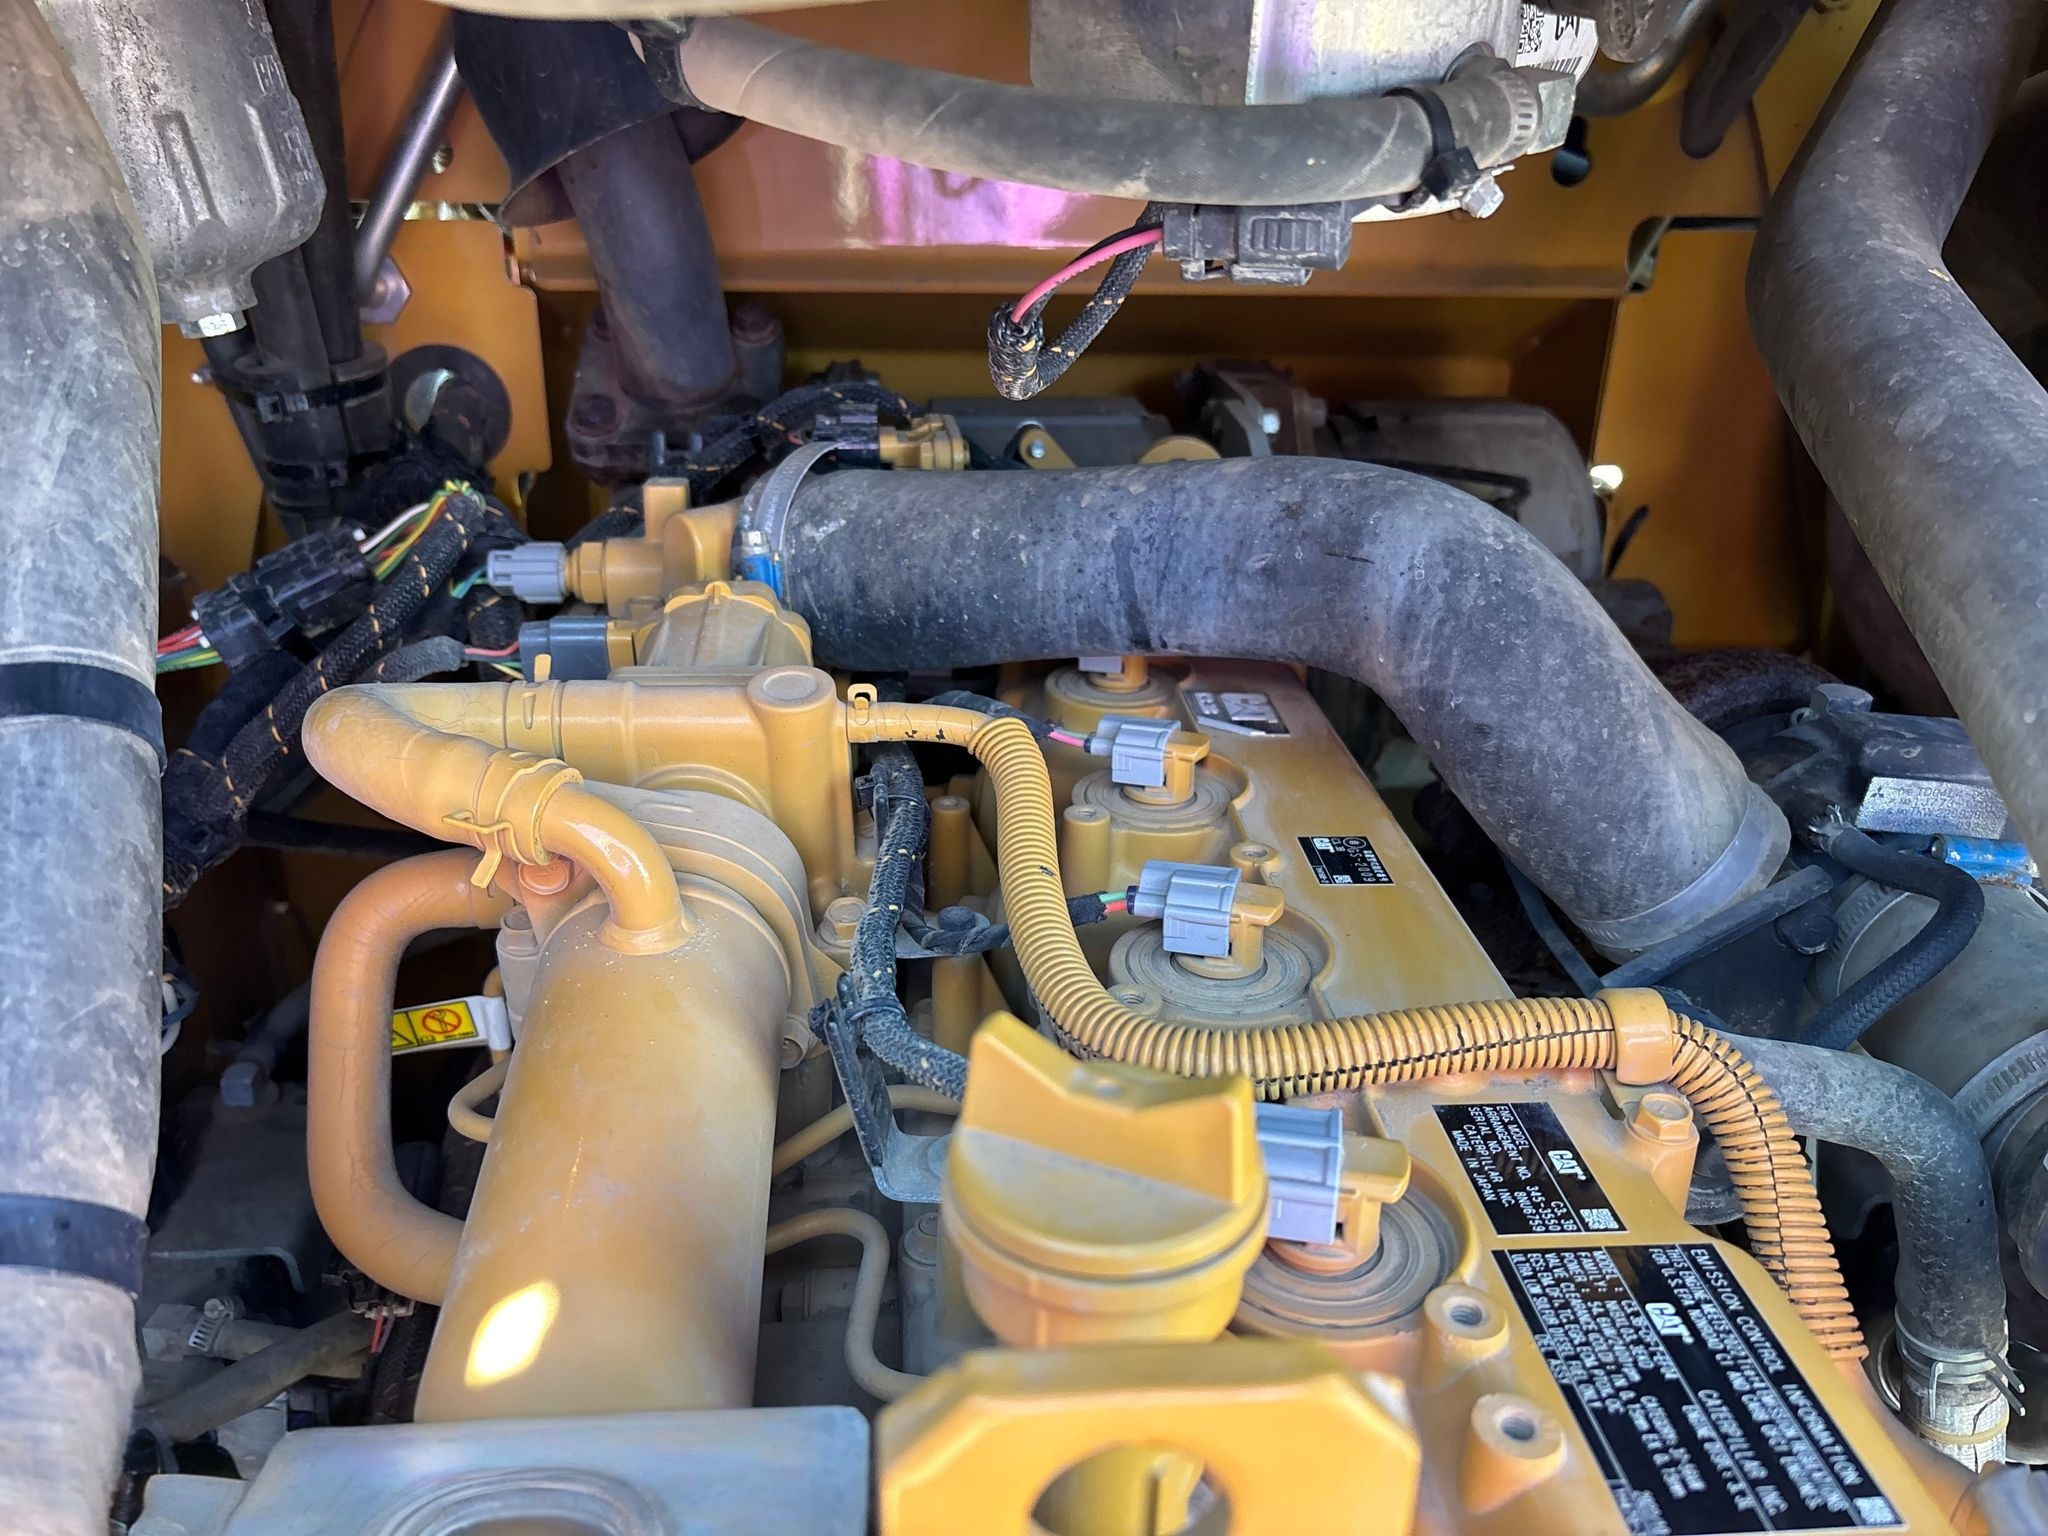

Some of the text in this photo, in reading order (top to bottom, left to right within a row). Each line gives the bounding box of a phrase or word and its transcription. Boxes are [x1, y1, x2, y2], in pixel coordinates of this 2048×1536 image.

[1507, 1124, 1530, 1150] MODEL
[1548, 1150, 1583, 1174] CAT
[1452, 1130, 1497, 1201] MADE IN JAPAN
[1463, 1124, 1515, 1208] CATERPILLAR INC.
[1468, 1106, 1492, 1136] SERIAL
[1514, 1191, 1546, 1232] 8NU6759
[1483, 1106, 1561, 1231] ARRANGEMENT NO. 345-3550
[1511, 1253, 1534, 1277] ULTRA
[1523, 1279, 1543, 1294] LOW
[1560, 1252, 1588, 1282] POWER
[1592, 1250, 1618, 1280] MODEL
[1665, 1248, 1688, 1268] THIS
[1679, 1270, 1710, 1300] ENGINE
[1701, 1303, 1729, 1331] MEETS
[1532, 1296, 1560, 1325] SULFUR
[1544, 1252, 1569, 1279] VALVE
[1560, 1282, 1598, 1331] CLEARANCE
[1610, 1374, 1628, 1387] IN
[1648, 1248, 1670, 1265] FOR
[1715, 1353, 1734, 1366] CI
[1726, 1371, 1751, 1391] AND
[1548, 1327, 1575, 1357] DIESEL
[1690, 1249, 1861, 1484] EMISSION CONTROL INFORMATION
[1566, 1360, 1588, 1382] FUEL
[1645, 1302, 1690, 1337] CAT
[1698, 1389, 1767, 1478] CATERPILLAR
